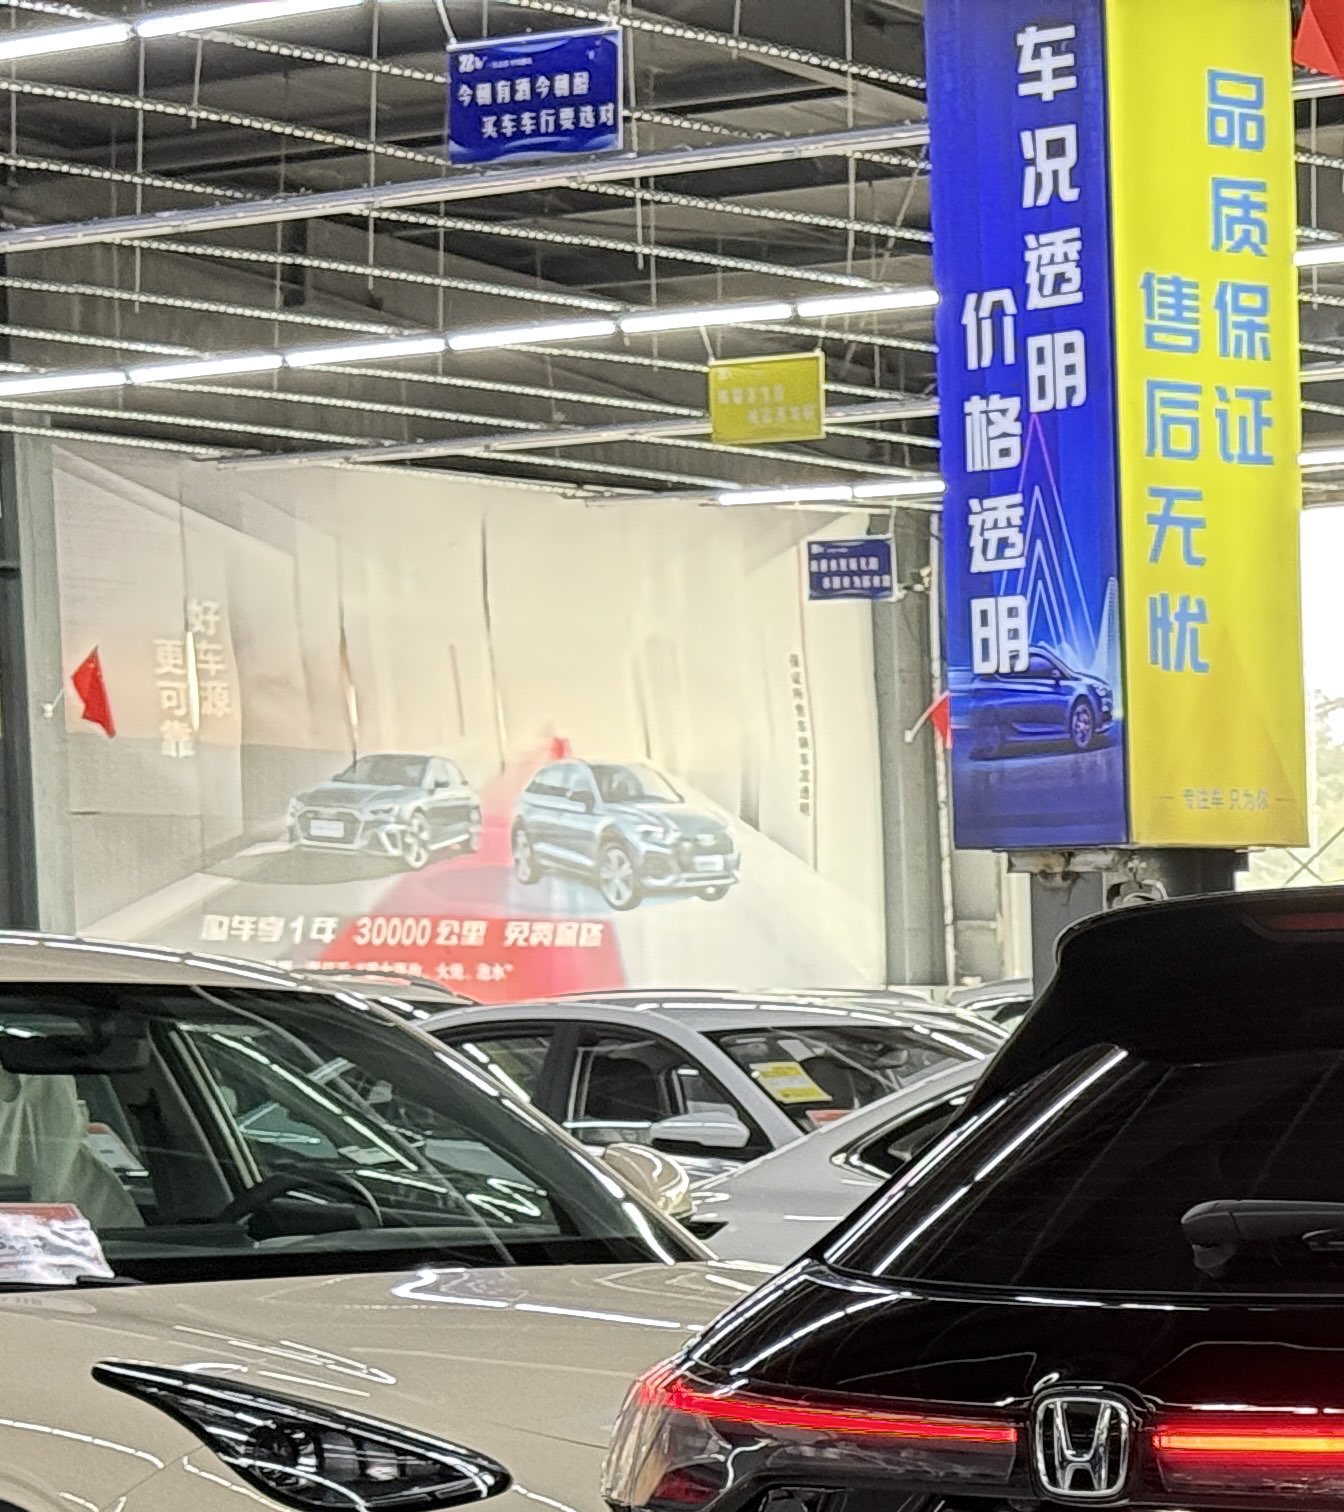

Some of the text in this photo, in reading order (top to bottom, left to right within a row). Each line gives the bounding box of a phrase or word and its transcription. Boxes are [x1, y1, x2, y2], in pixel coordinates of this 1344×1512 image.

[481, 103, 615, 138] 买车车行要选对
[1015, 24, 1087, 412] 车况透明
[1206, 69, 1274, 466] 品质保证
[960, 288, 1029, 674] 价格透明
[1139, 271, 1210, 674] 售后无忧
[153, 639, 195, 759] 更可靠
[354, 916, 432, 946] 30000
[435, 919, 488, 947] 公里
